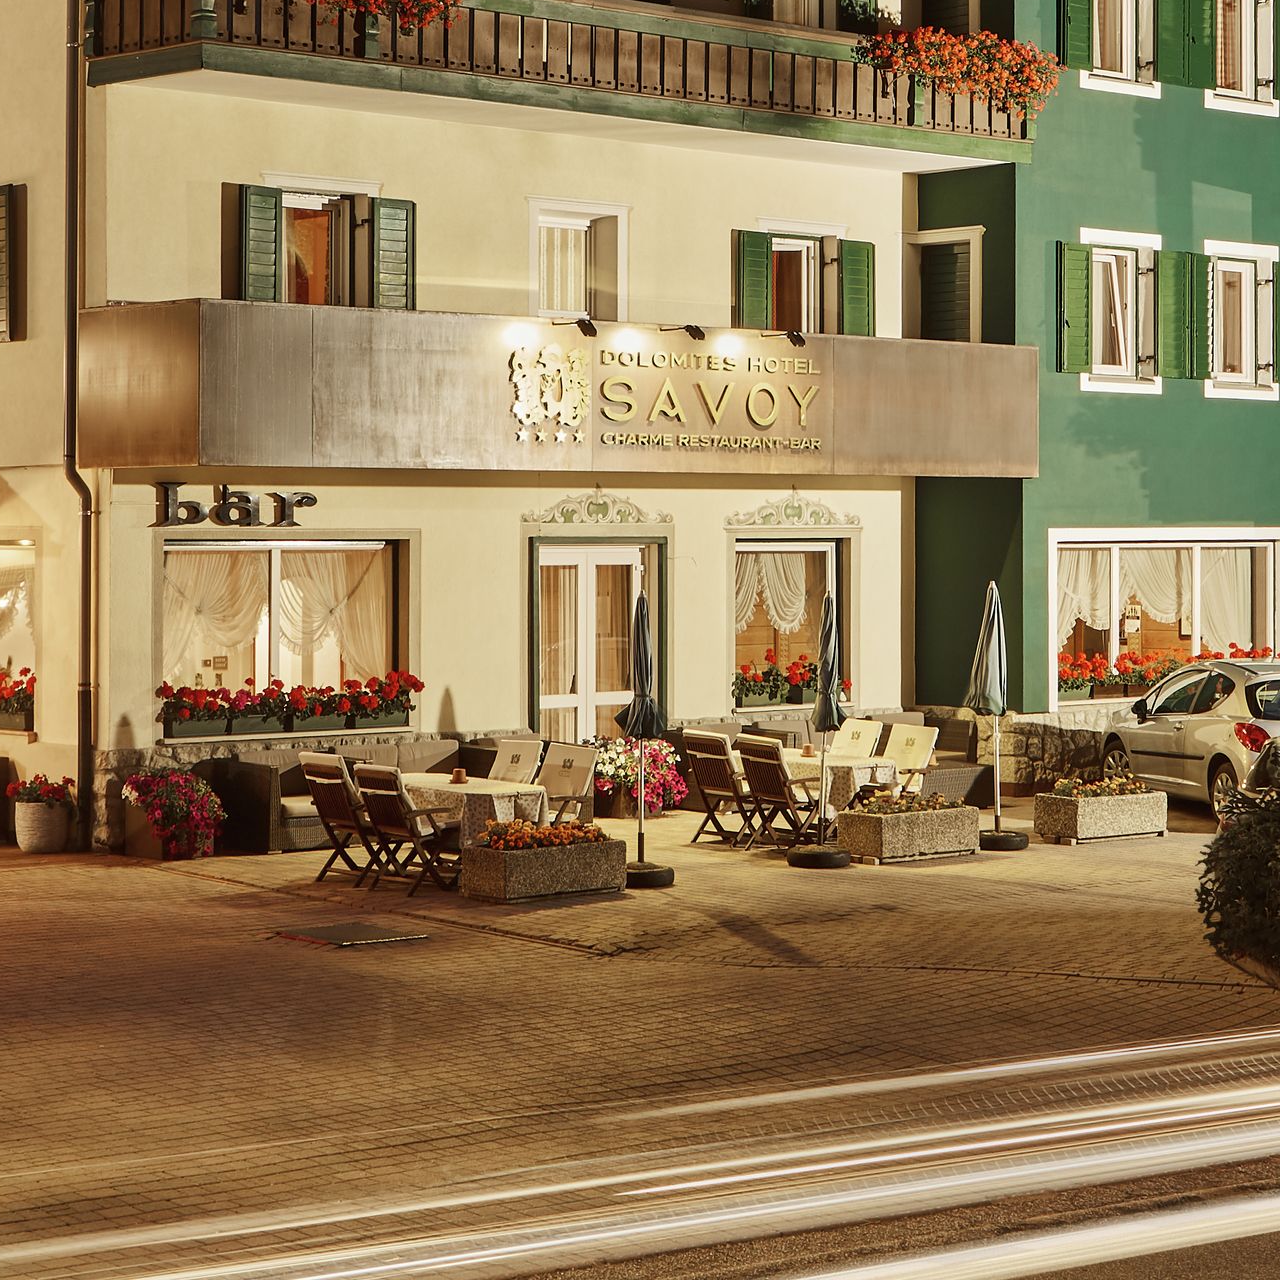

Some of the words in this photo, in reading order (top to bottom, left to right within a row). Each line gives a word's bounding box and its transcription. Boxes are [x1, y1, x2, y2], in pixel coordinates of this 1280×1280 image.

[600, 349, 736, 371] DOLOMITES
[748, 356, 821, 375] HOTEL
[600, 375, 820, 428] SAVOY
[601, 431, 673, 447] CHARME
[677, 433, 822, 451] RESTAURANT-BAR
[147, 481, 318, 528] bar
